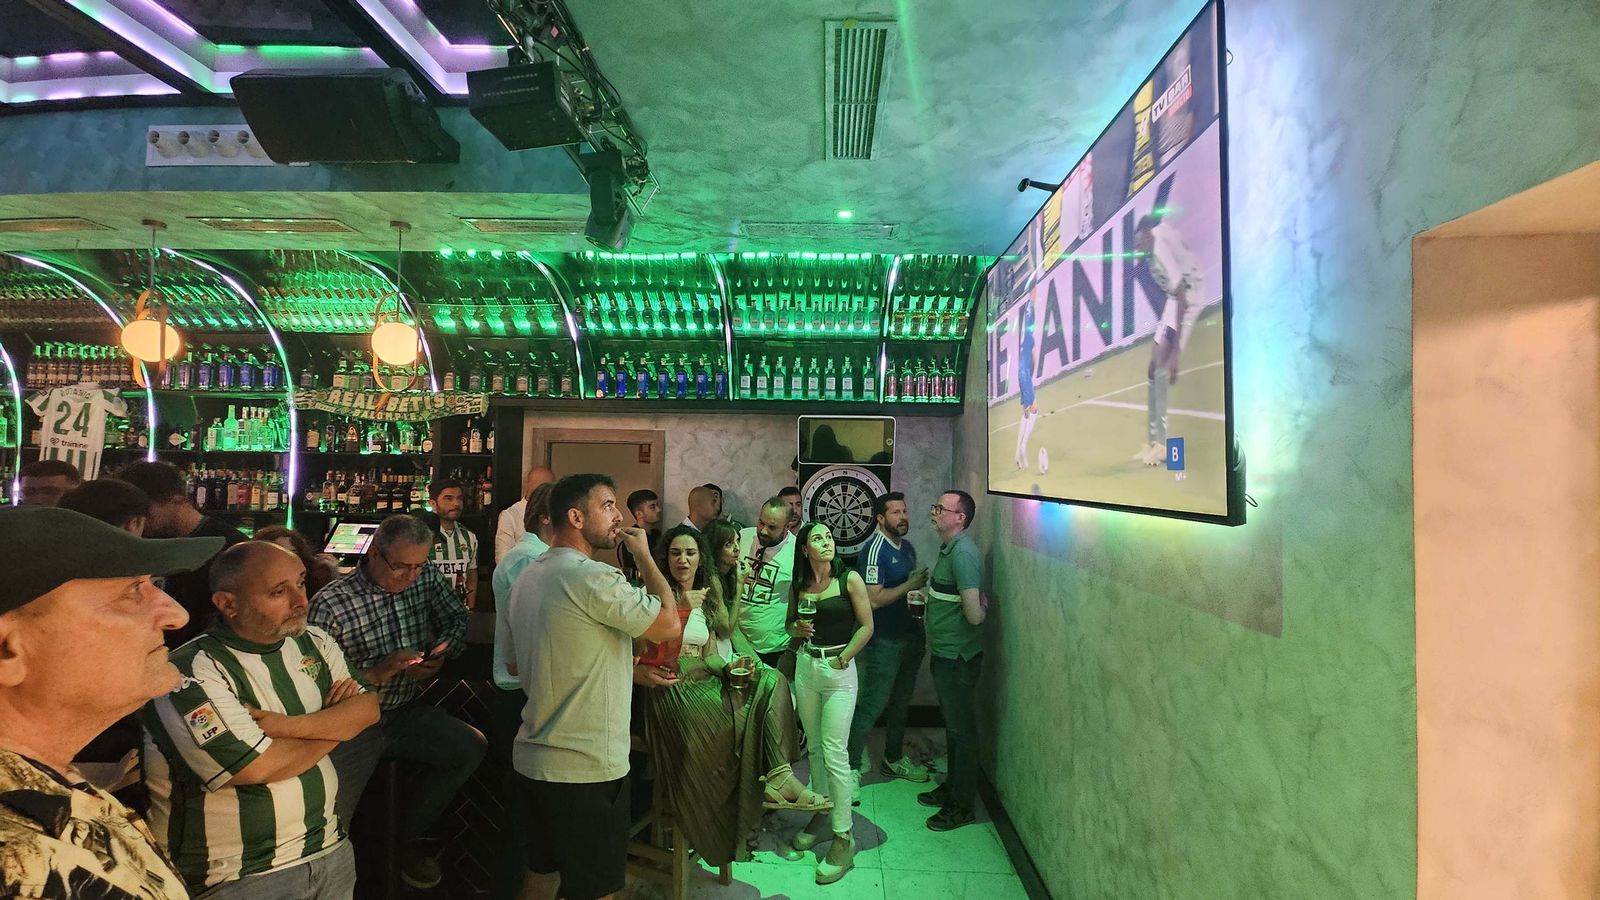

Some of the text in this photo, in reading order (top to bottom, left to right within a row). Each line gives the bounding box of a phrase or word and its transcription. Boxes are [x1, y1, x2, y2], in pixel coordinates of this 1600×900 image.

[1153, 98, 1165, 116] TV
[1167, 70, 1190, 103] BAR
[1019, 170, 1177, 380] ANK
[327, 389, 376, 410] REAL
[385, 393, 445, 412] BETIS
[53, 401, 92, 438] 24
[1172, 446, 1179, 462] B
[201, 726, 218, 741] LFP
